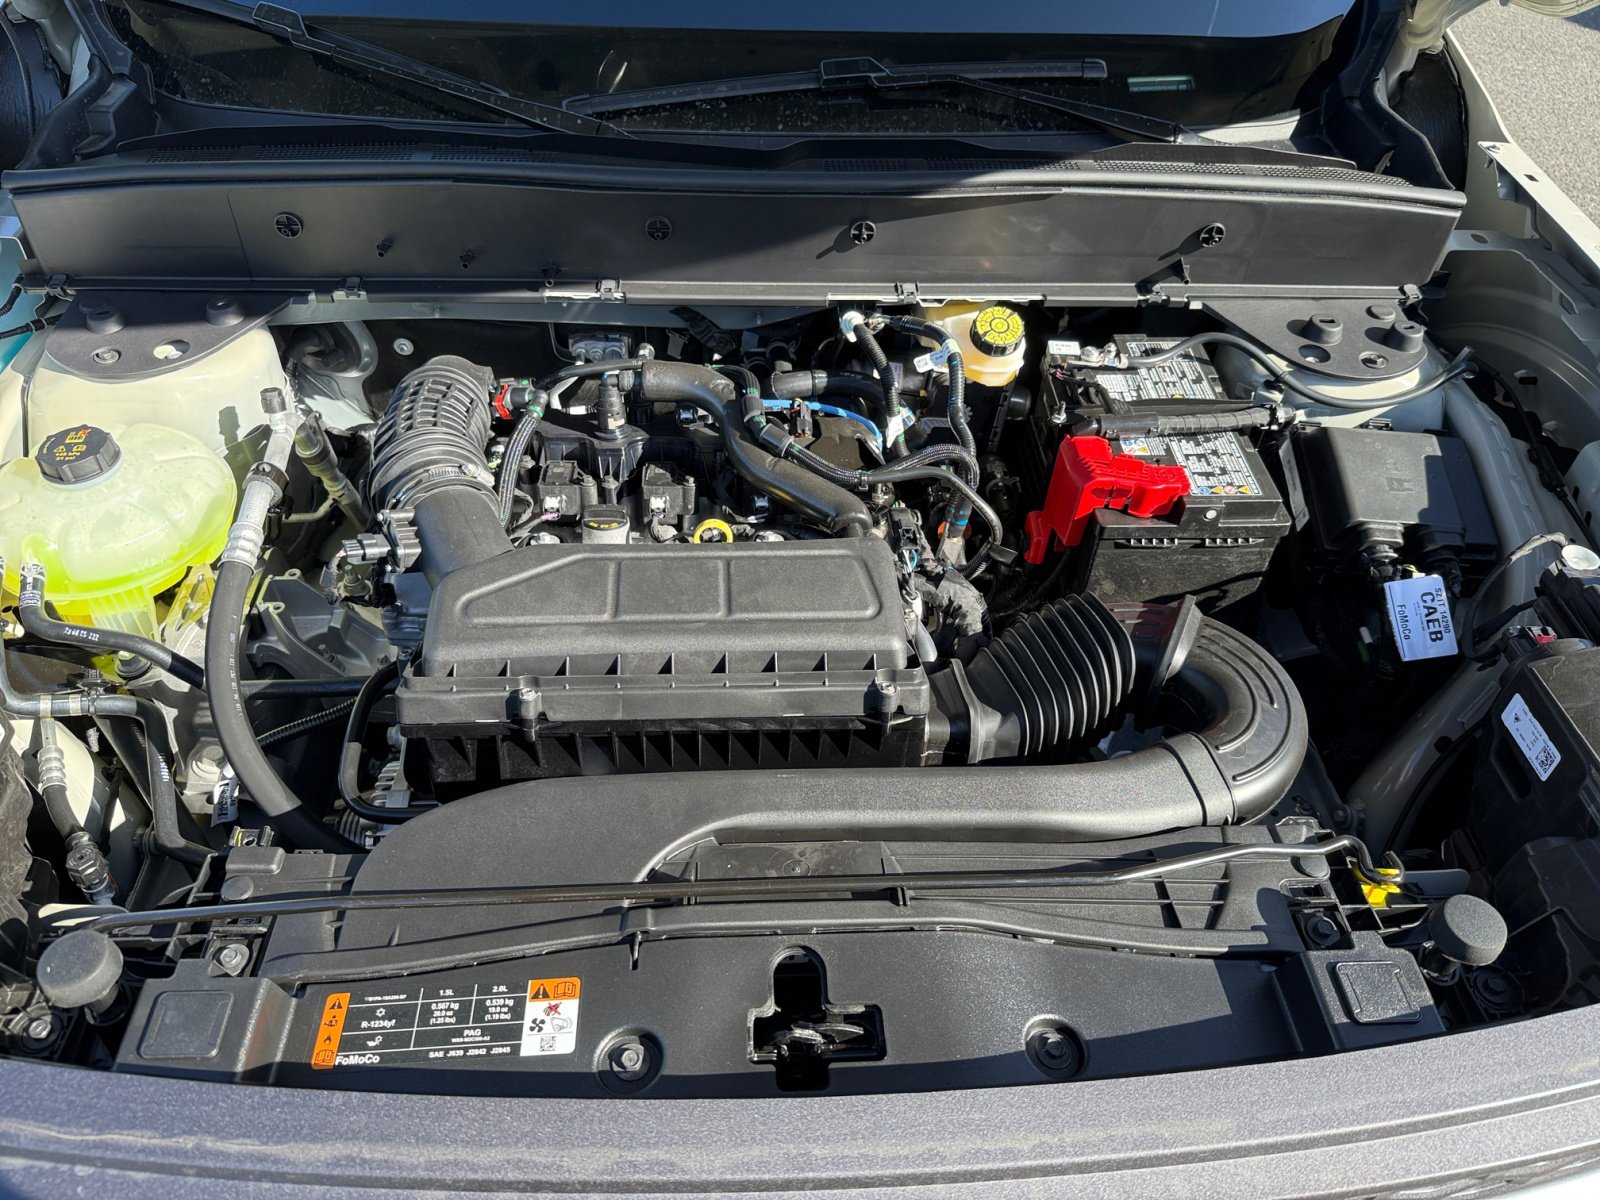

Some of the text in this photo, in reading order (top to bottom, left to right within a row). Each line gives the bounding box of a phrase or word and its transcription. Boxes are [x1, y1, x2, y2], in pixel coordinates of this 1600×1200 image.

[1420, 591, 1444, 643] CAEB
[1396, 604, 1412, 640] FoMoCo
[1440, 611, 1451, 634] 14290
[492, 985, 508, 993] 2.0L
[450, 1002, 460, 1010] kg
[504, 998, 515, 1006] kg
[360, 1019, 397, 1029] R-1234yf
[463, 1029, 482, 1037] PAG
[446, 1049, 464, 1057] J639
[335, 1054, 380, 1066] FoMoCo
